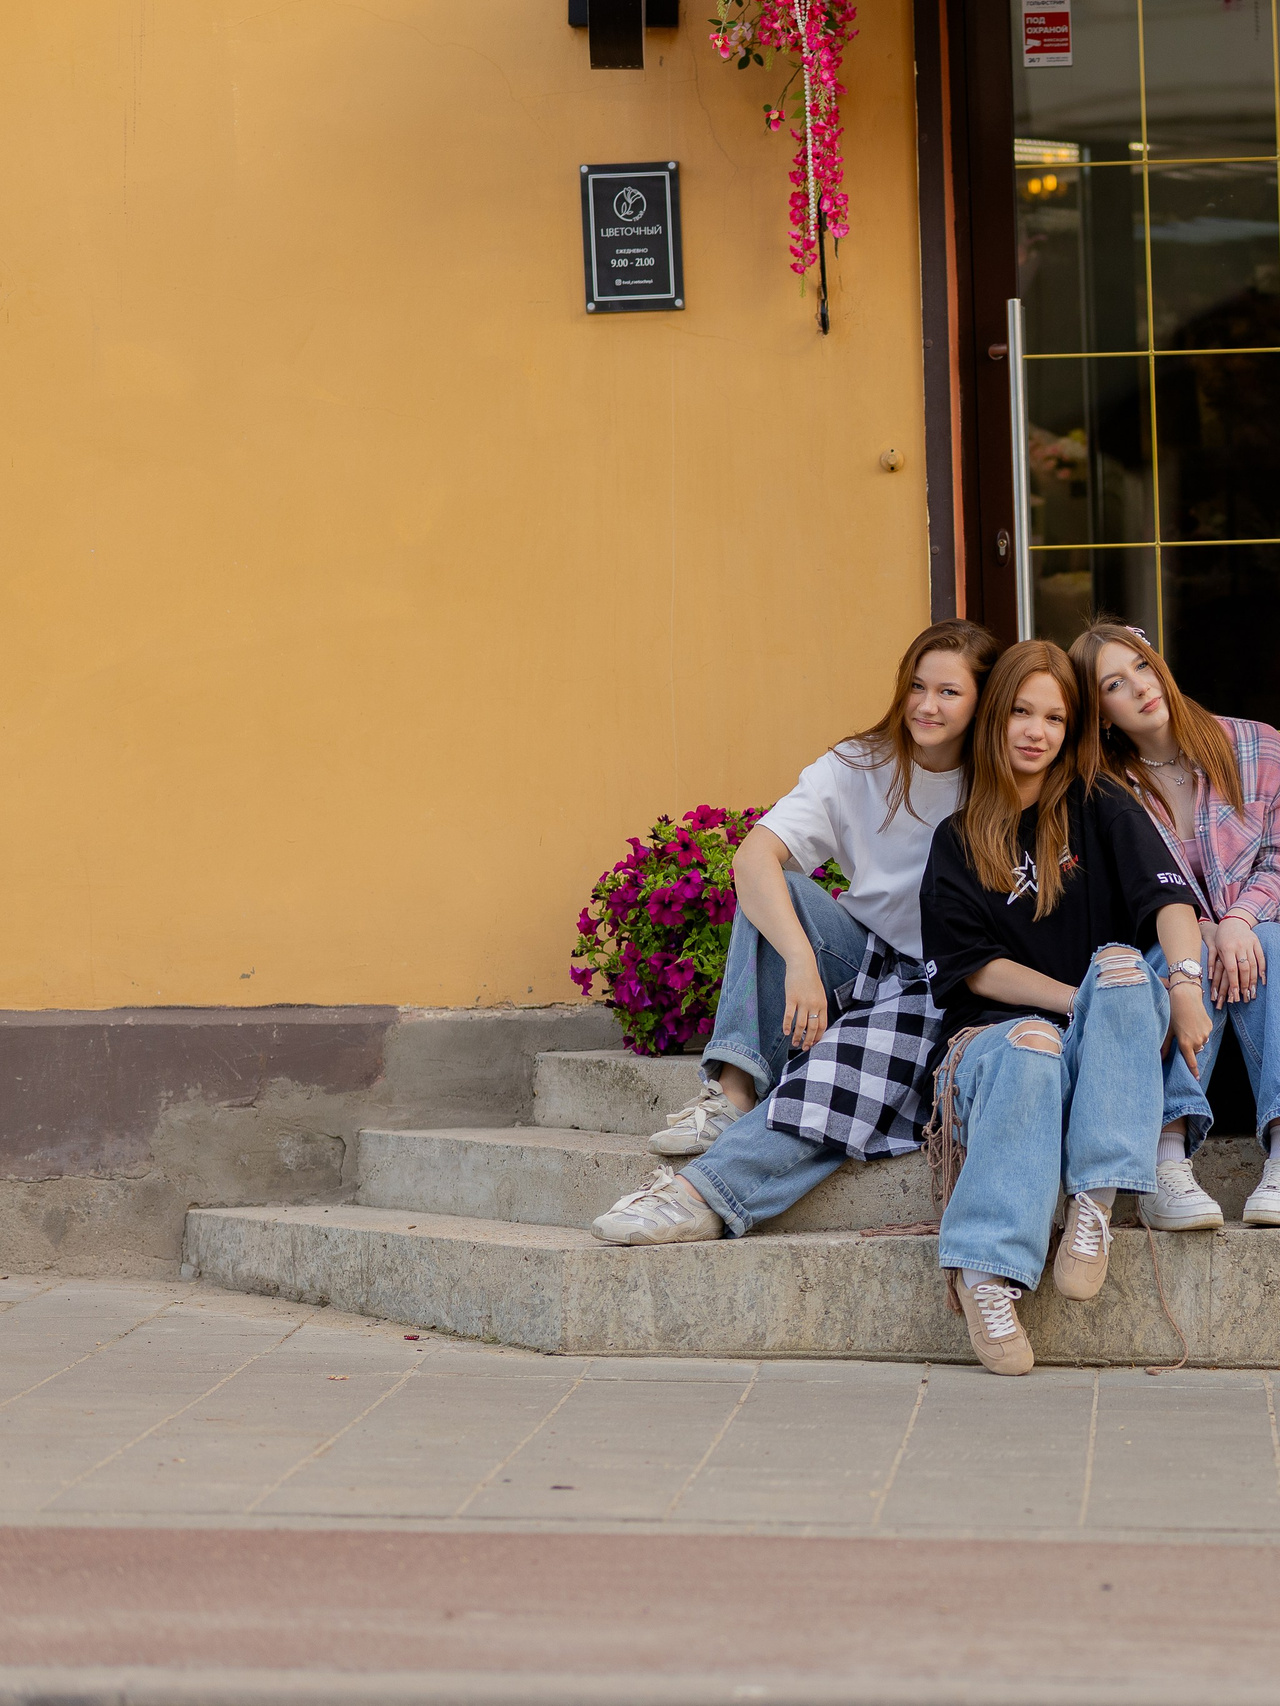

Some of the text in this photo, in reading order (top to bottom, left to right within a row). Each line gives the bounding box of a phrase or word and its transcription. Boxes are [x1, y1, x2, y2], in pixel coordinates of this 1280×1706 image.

[1026, 25, 1068, 34] ОХРАНОЙ
[601, 224, 662, 238] ЦВЕТОЧНЫЙ
[615, 247, 648, 255] ЕЖЕДНЕВНО
[611, 258, 628, 268] 9.00
[635, 257, 655, 267] 21.00
